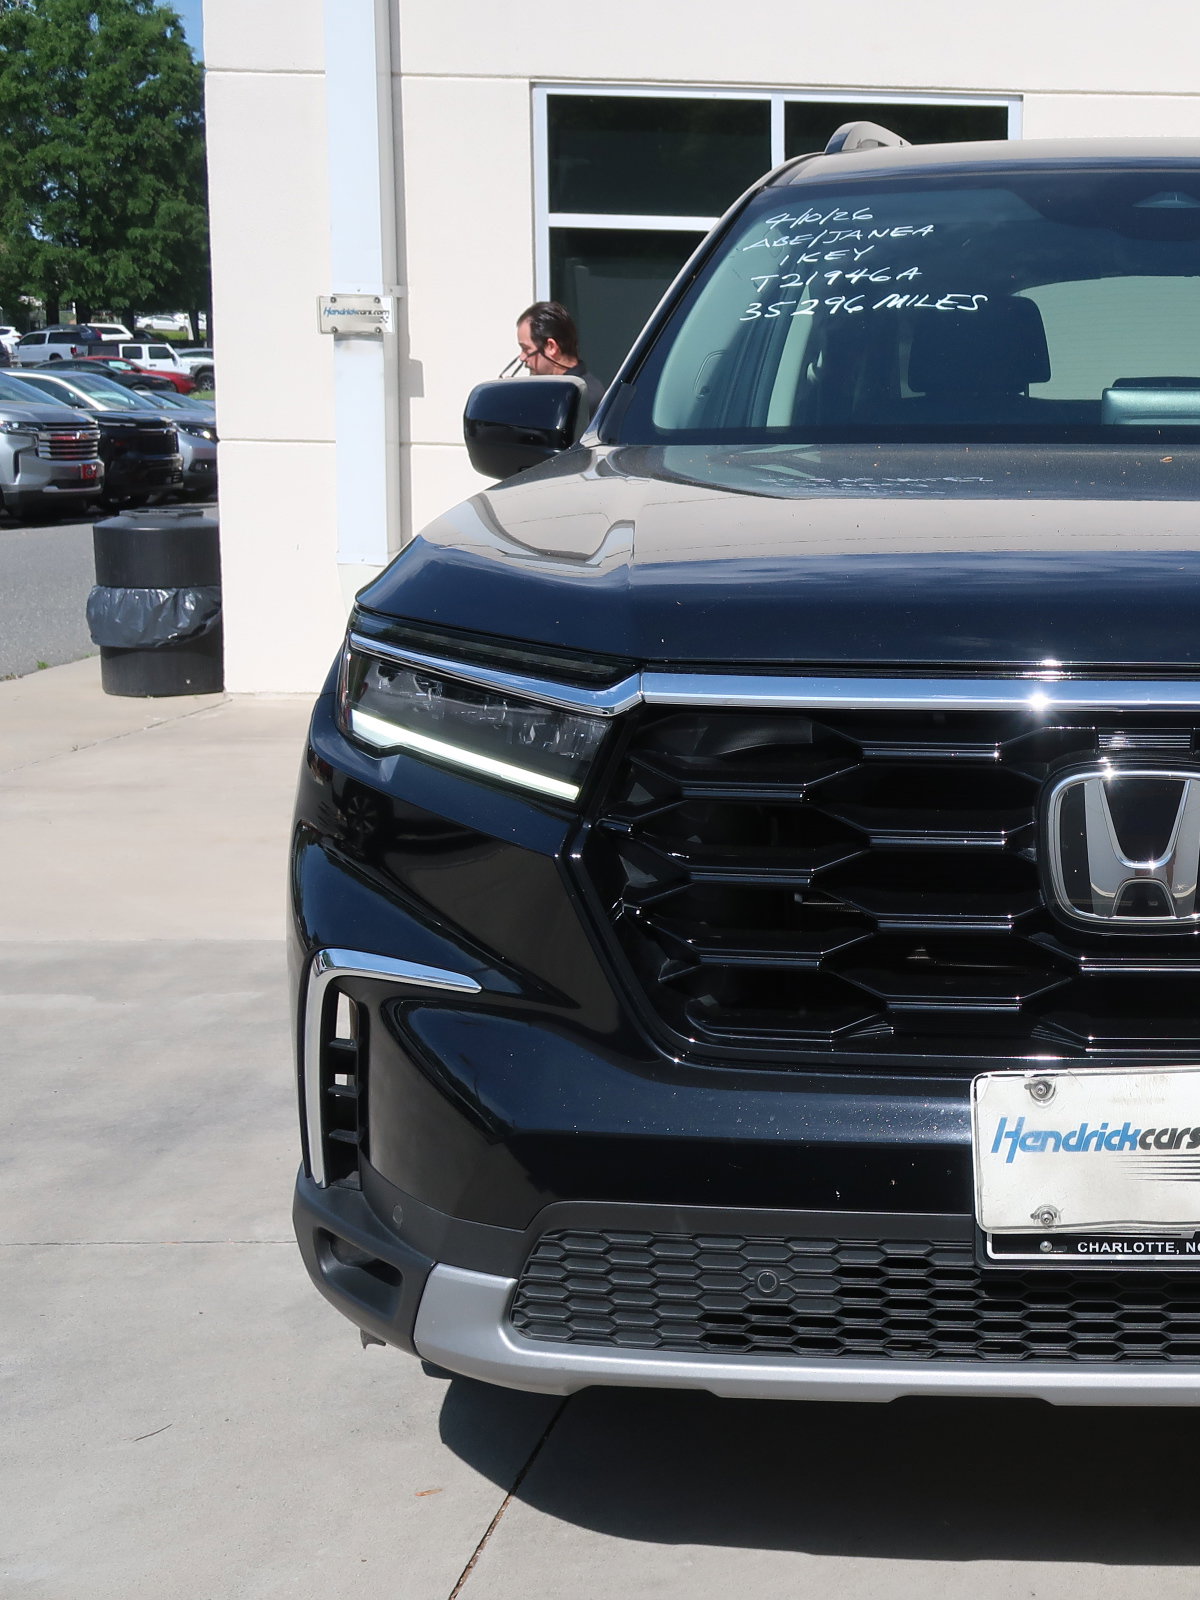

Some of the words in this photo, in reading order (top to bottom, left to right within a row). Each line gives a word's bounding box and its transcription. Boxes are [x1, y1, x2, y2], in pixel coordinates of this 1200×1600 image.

[765, 208, 873, 229] 4/10/26
[797, 245, 874, 264] KEY
[740, 294, 866, 321] 35296
[872, 293, 988, 311] MILES
[1077, 1241, 1180, 1255] CHARLOTTE,
